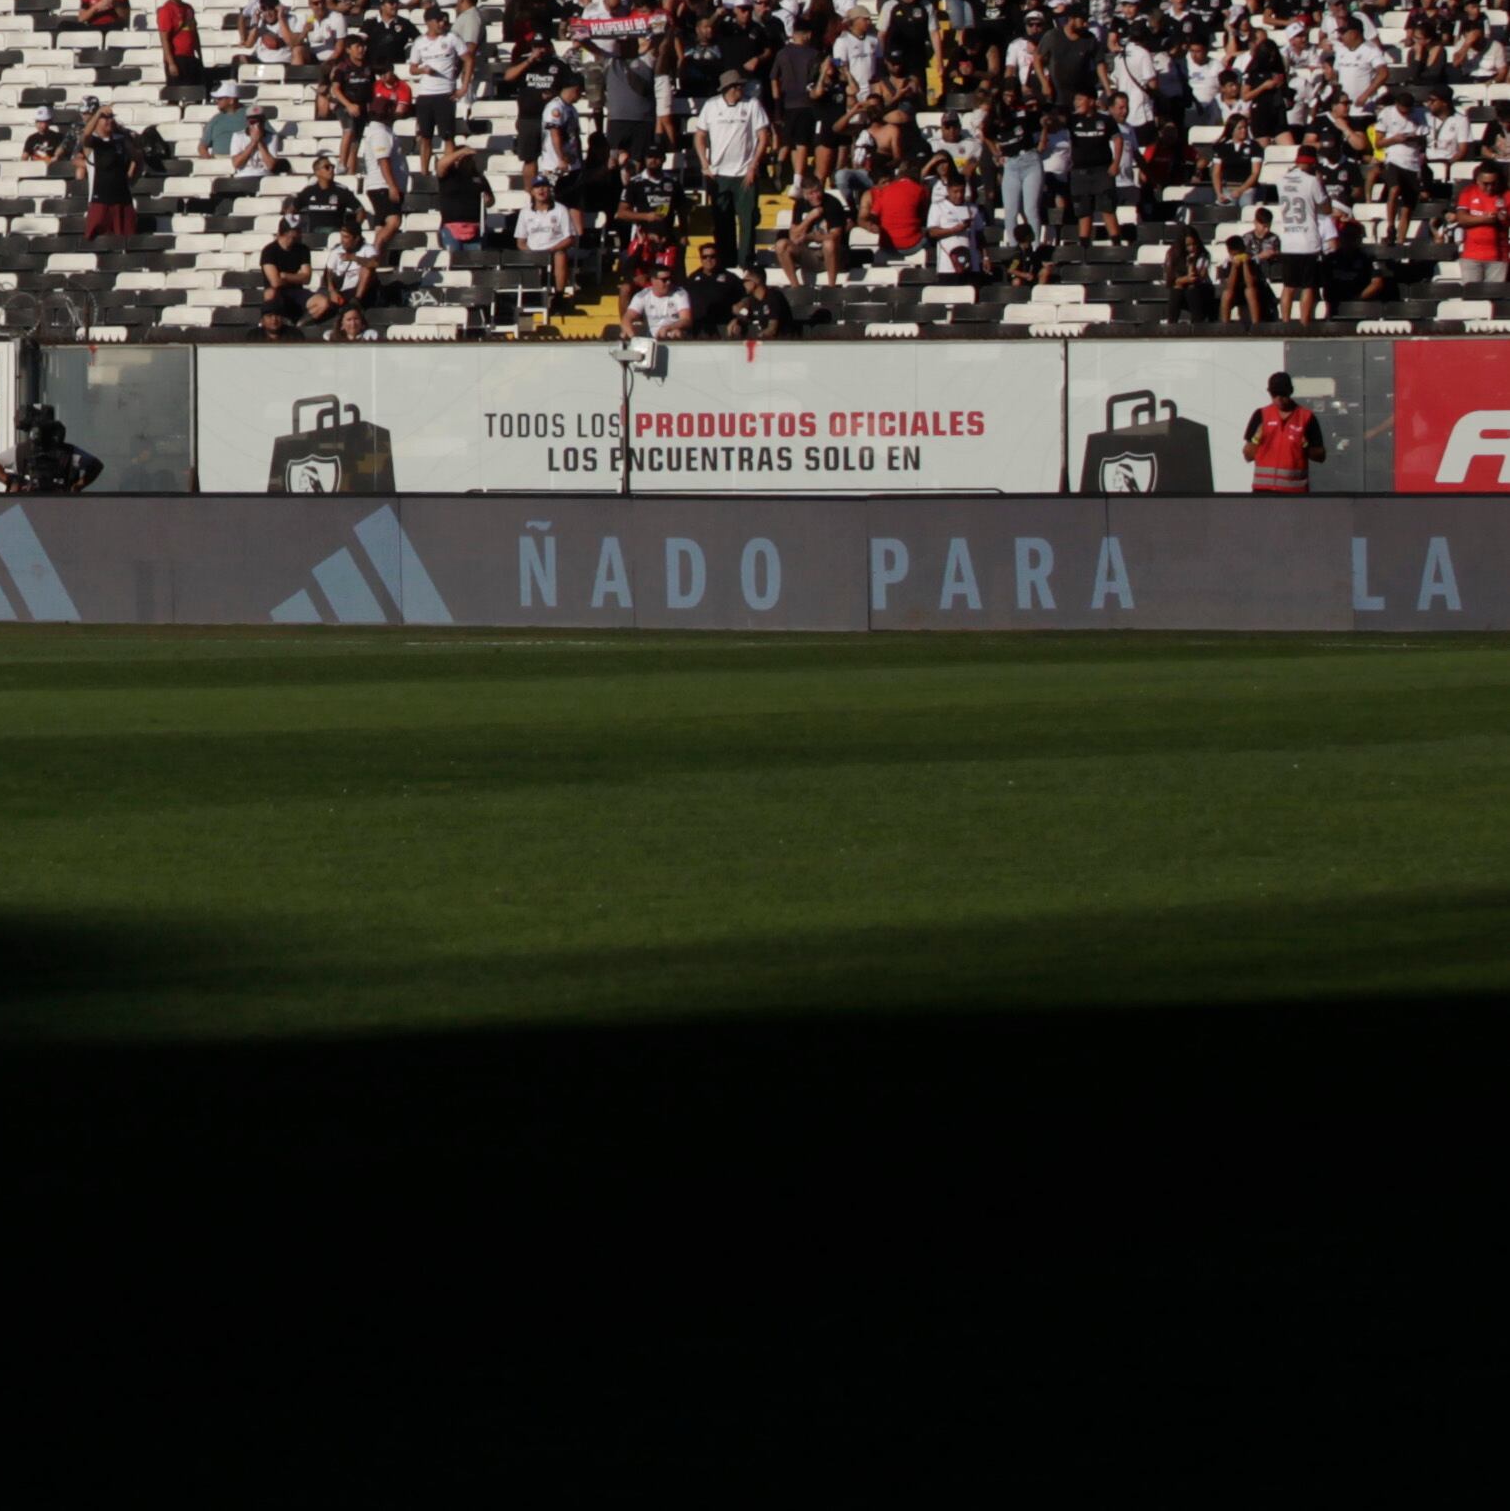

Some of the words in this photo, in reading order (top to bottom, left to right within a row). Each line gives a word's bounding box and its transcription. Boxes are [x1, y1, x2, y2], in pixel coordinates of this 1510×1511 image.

[1280, 195, 1306, 224] 23
[485, 413, 565, 438] TODOS
[577, 413, 621, 438] LOS
[635, 411, 818, 438] PRODUCTOS
[828, 410, 985, 437] OFICIALES
[547, 447, 598, 472] LOS
[610, 447, 793, 472] ENCUENTRAS
[804, 446, 875, 471] SOLO
[887, 446, 921, 470] EN
[518, 520, 782, 610] ÑADO
[870, 535, 1136, 609] PARA
[1351, 536, 1463, 611] LA
